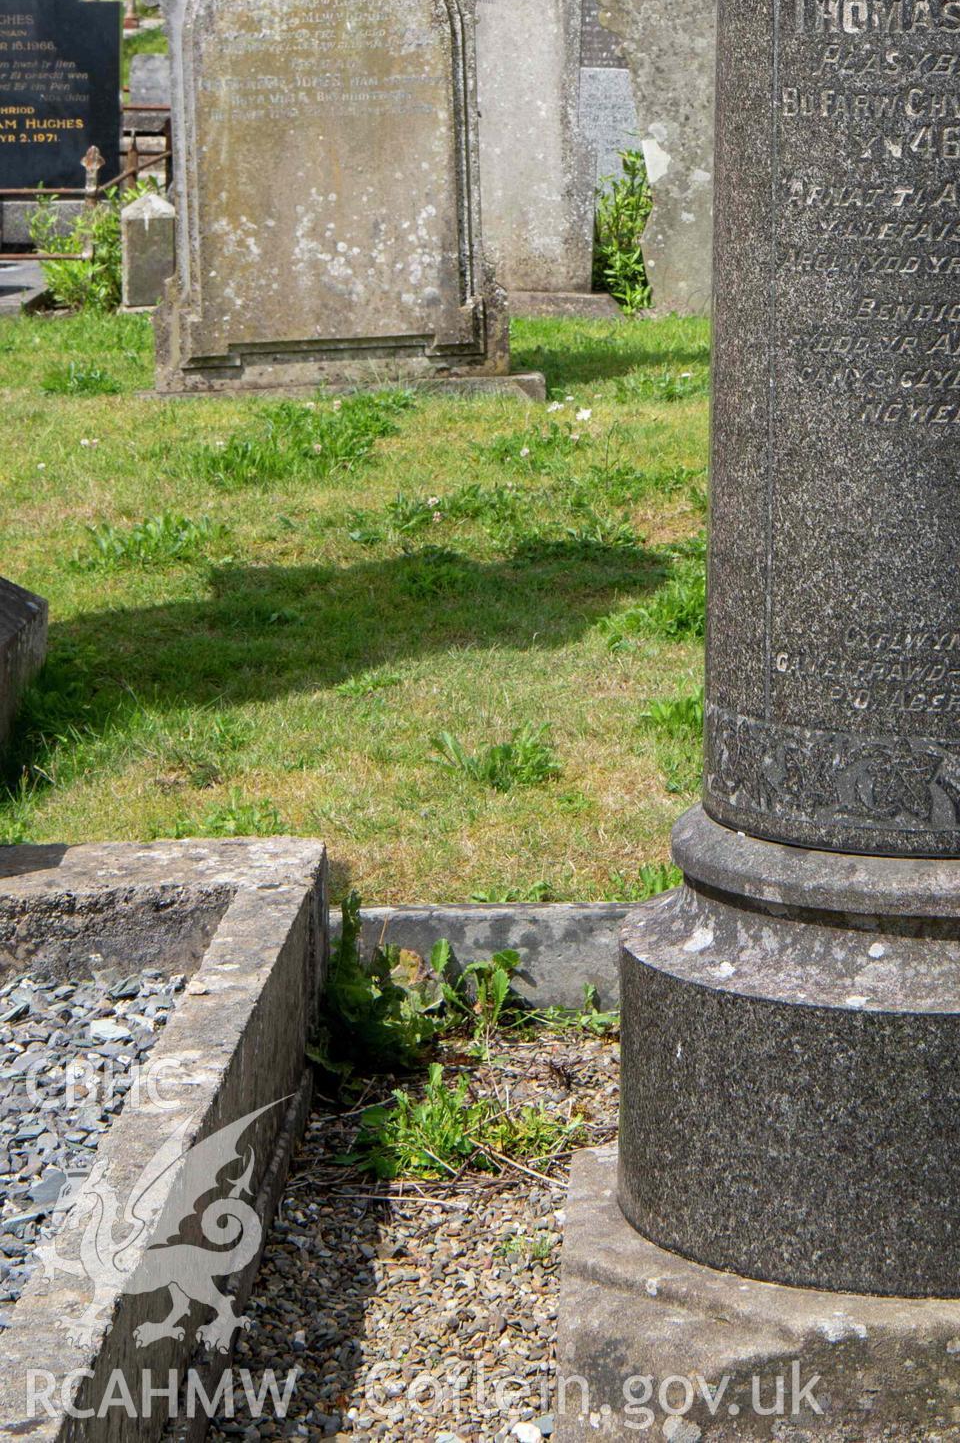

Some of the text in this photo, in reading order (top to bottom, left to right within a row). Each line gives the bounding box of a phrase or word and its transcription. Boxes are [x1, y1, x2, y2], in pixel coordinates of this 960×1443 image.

[820, 87, 902, 118] FARW
[25, 118, 85, 130] HUGHES
[853, 133, 902, 159] YN
